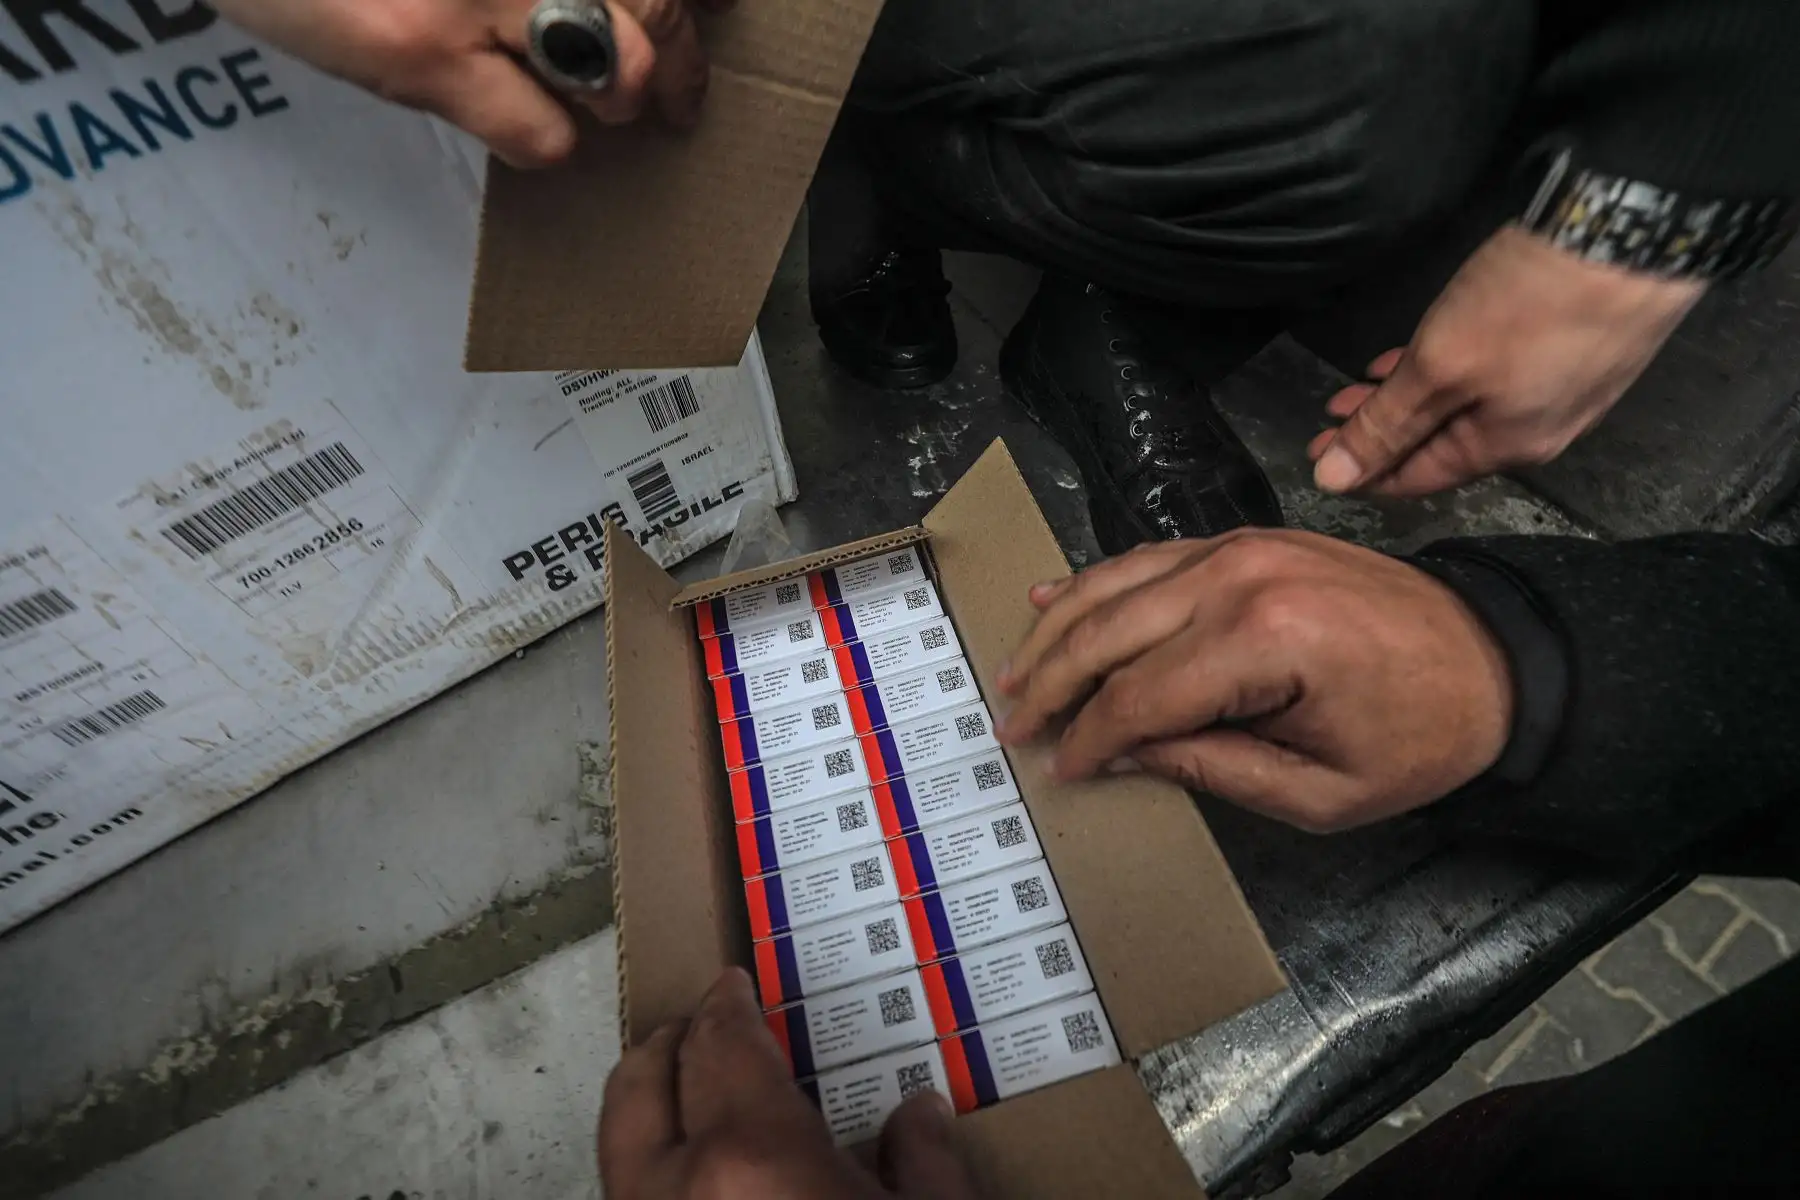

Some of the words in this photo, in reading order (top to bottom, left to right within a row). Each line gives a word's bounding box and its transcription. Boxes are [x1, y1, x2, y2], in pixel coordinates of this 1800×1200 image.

[616, 377, 633, 389] ALL
[681, 445, 715, 466] ISRAEL
[545, 563, 578, 592] &
